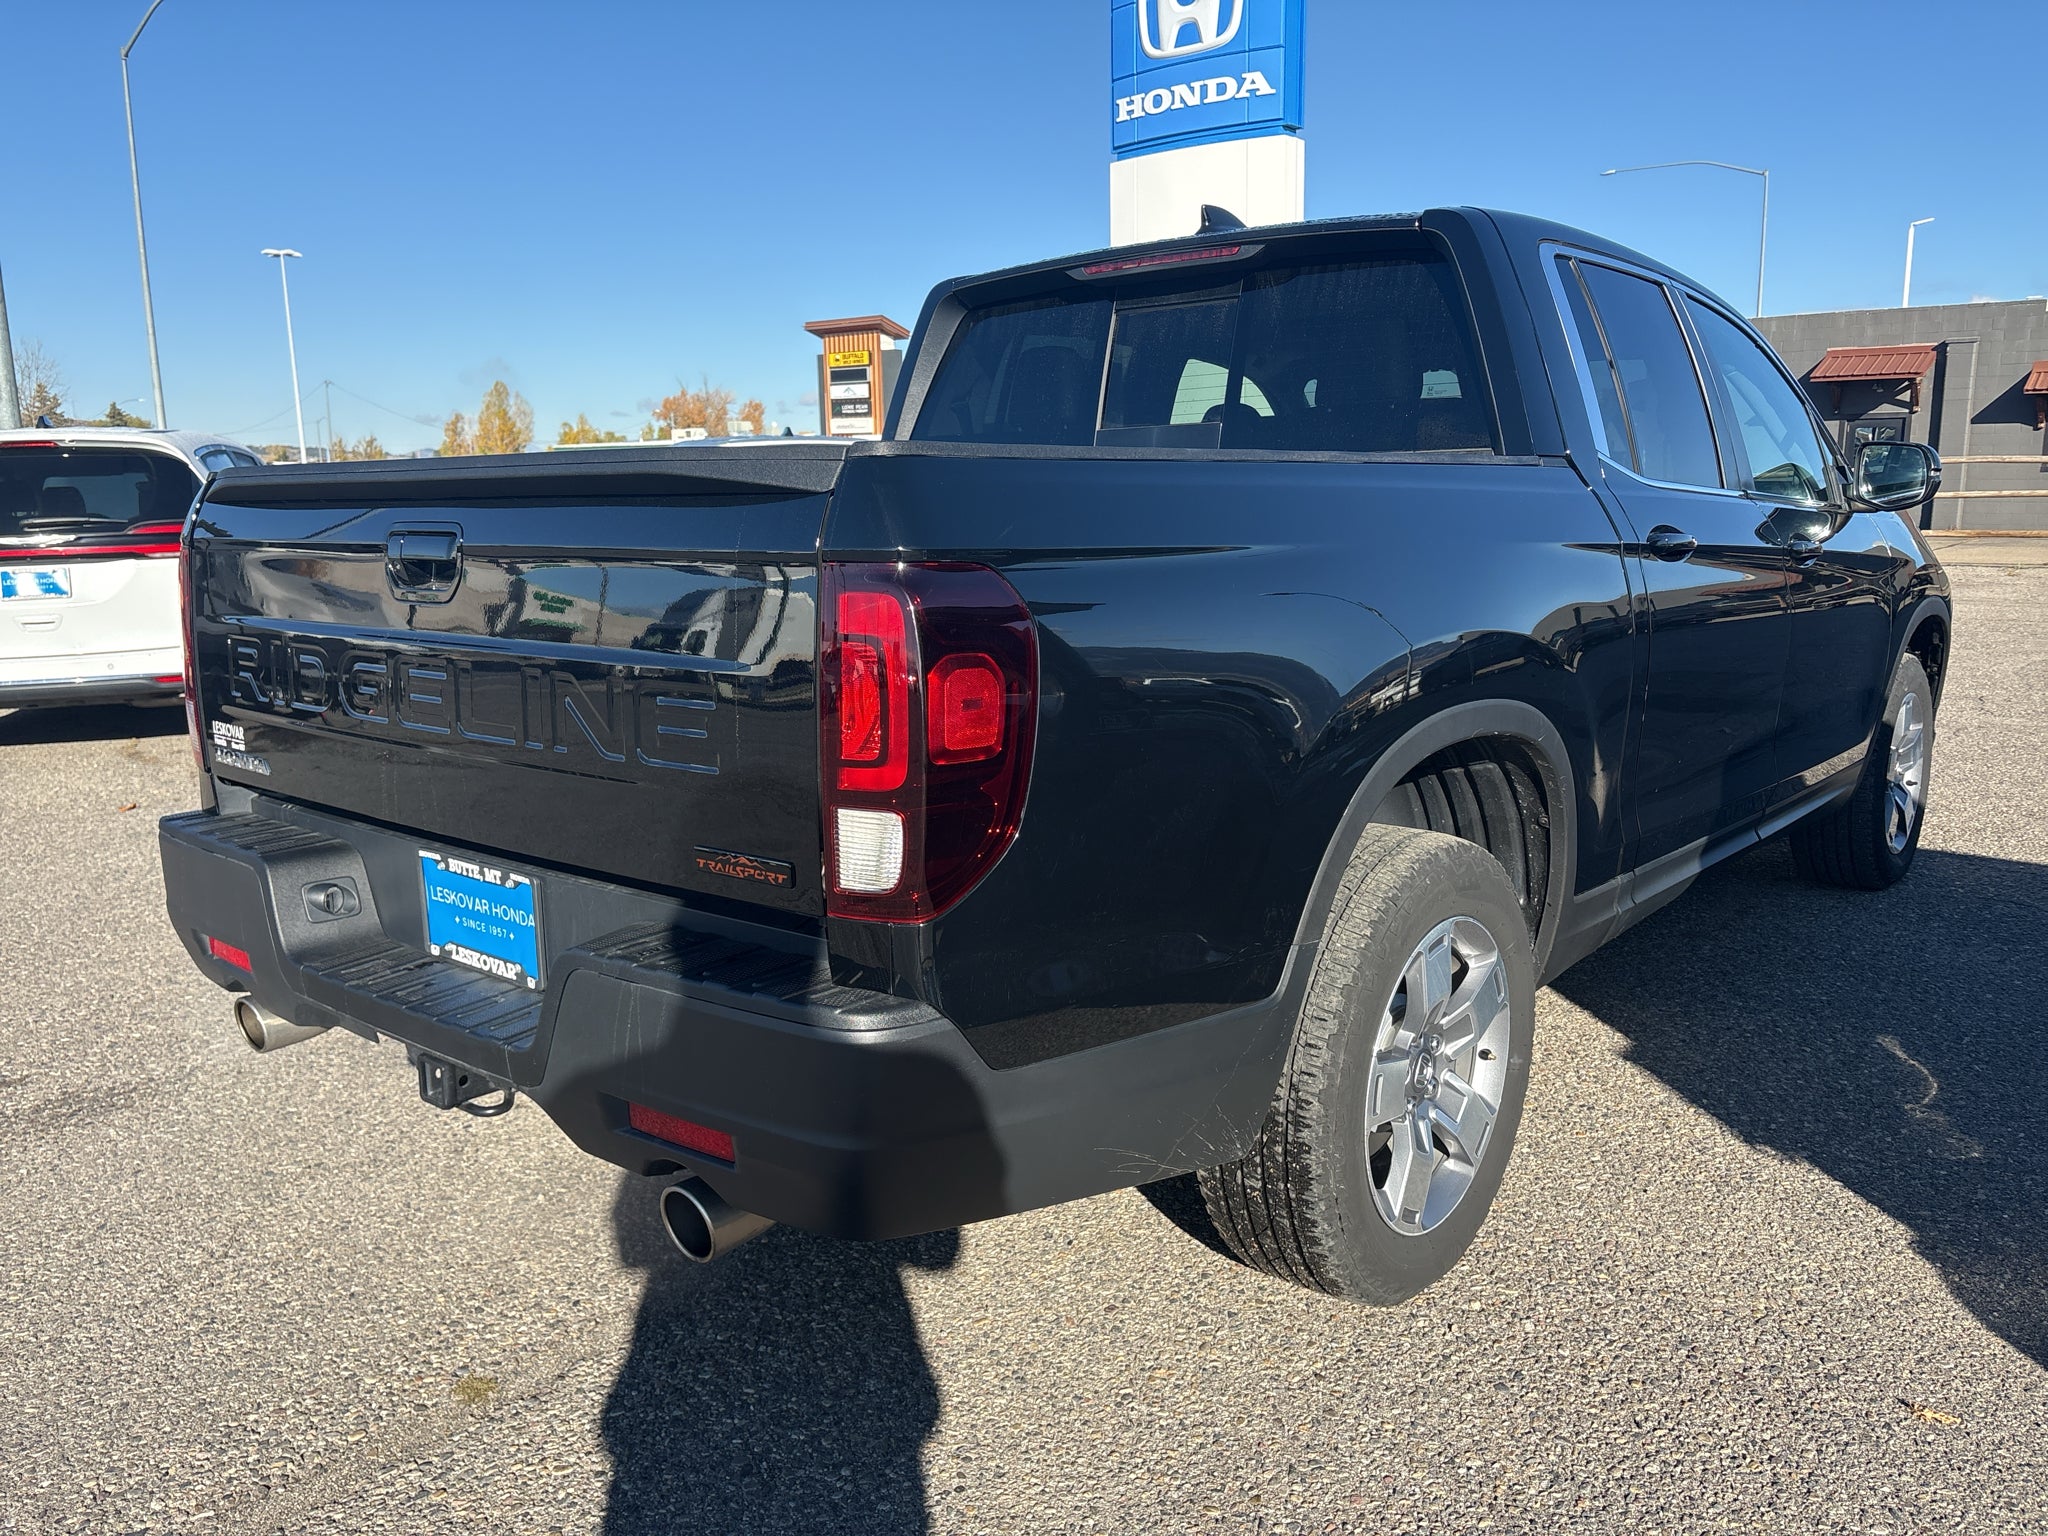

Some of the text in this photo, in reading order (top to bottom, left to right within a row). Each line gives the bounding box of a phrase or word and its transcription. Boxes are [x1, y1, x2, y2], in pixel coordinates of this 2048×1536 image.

[1115, 71, 1276, 123] HONDA
[227, 634, 720, 775] RIDGELINE
[212, 719, 245, 740] LESKOVAR
[447, 857, 502, 885] BUTTE, MT
[696, 858, 788, 885] TRAILSPORT
[430, 885, 535, 928] LESKOVAR HONDA
[462, 917, 507, 938] SINCE 1957
